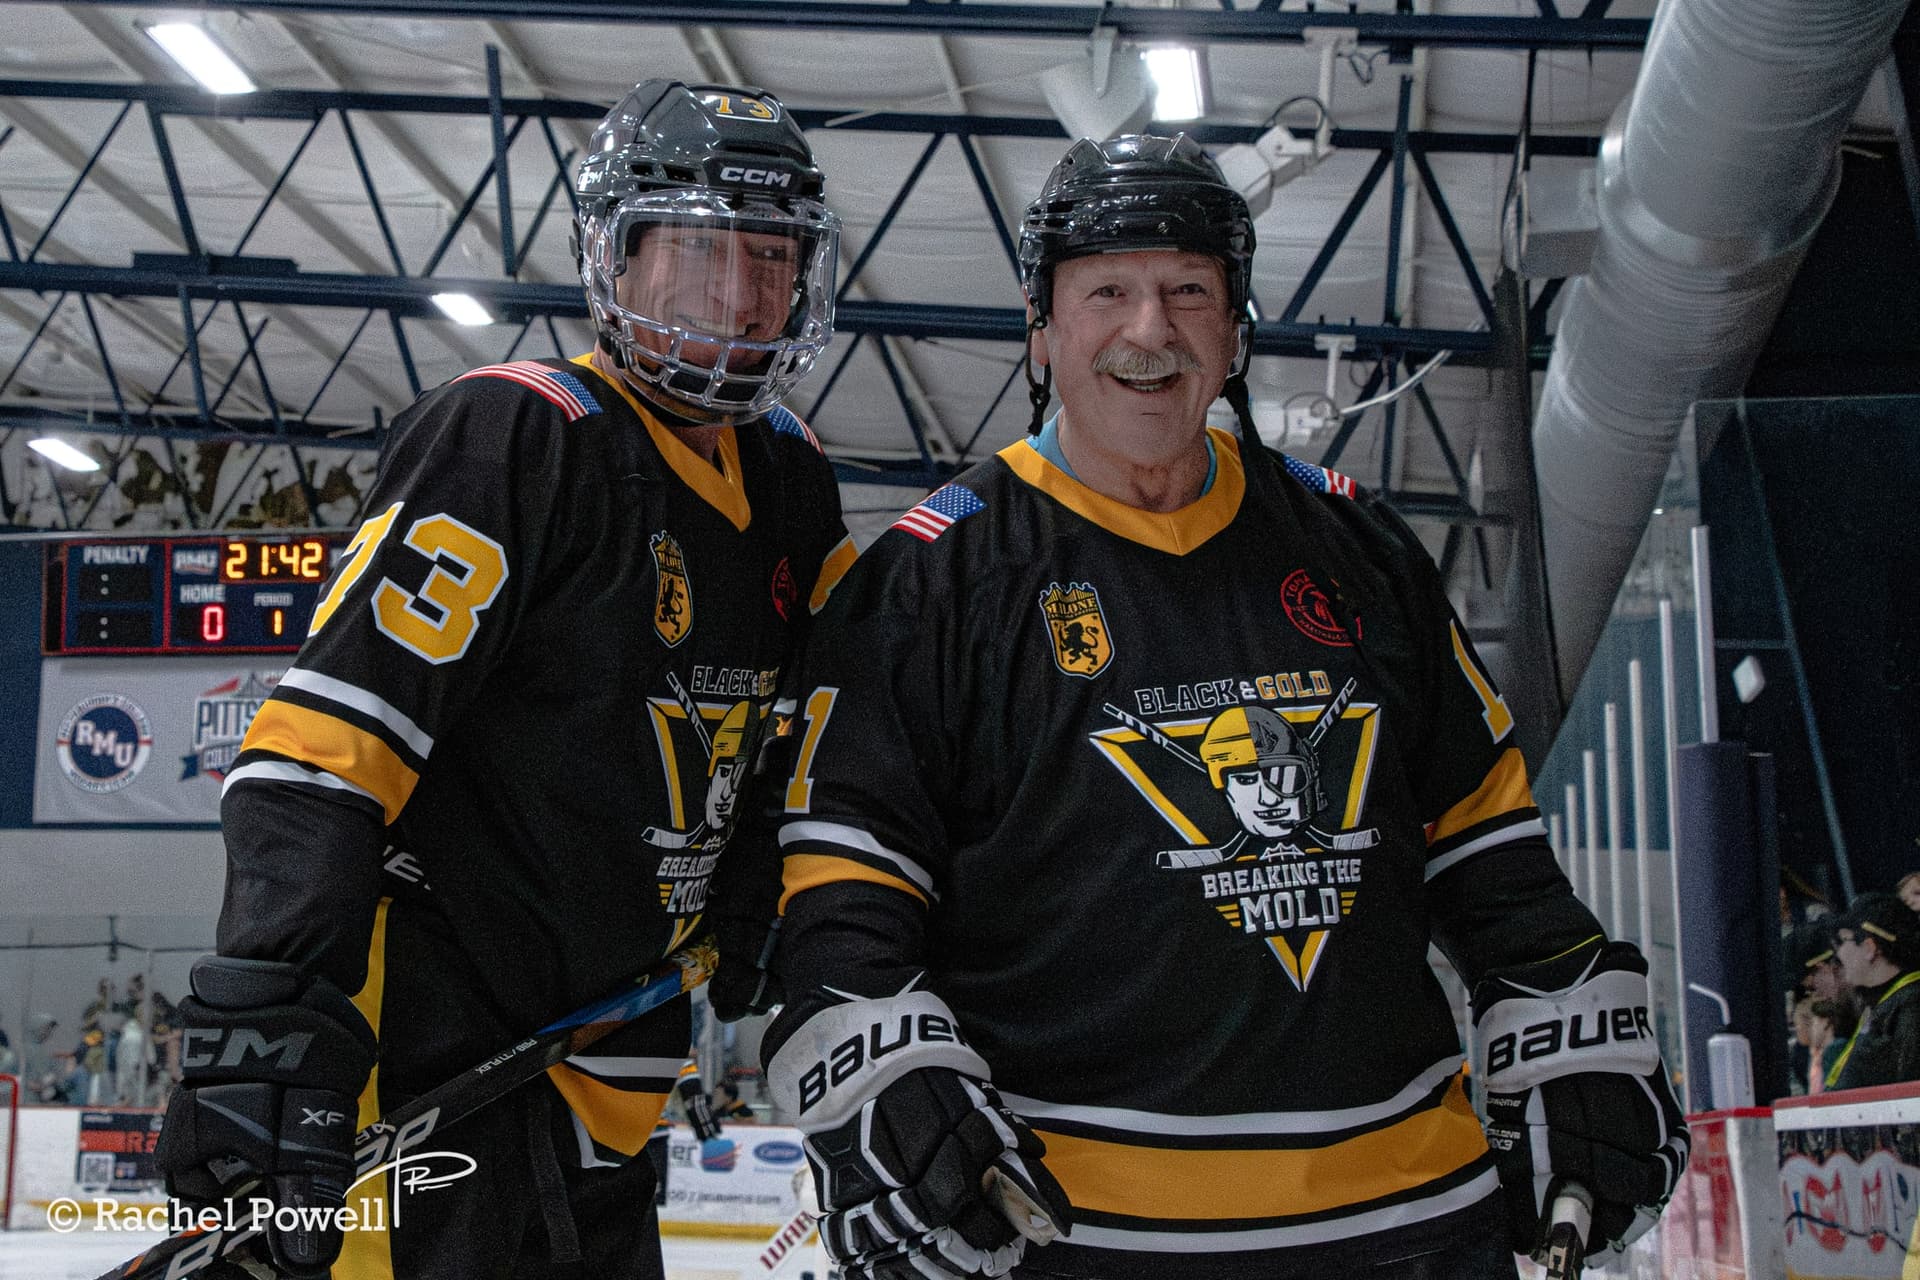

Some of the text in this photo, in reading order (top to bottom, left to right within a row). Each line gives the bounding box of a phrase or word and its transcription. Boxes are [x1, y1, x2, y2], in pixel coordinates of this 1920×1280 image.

[719, 166, 792, 189] CCM
[83, 546, 149, 564] PENALTY
[225, 542, 323, 579] 21:42
[180, 584, 226, 604] HOME
[203, 605, 224, 641] 0
[273, 609, 283, 636] 1
[690, 665, 755, 697] BLACK
[1135, 678, 1240, 716] BLACK
[1255, 670, 1333, 701] GOLD
[76, 720, 135, 768] RMU
[784, 686, 840, 814] 1
[1202, 858, 1362, 899] BREAKING THE
[1240, 887, 1341, 934] MOLD
[183, 1028, 316, 1072] CM
[301, 1107, 345, 1127] XF
